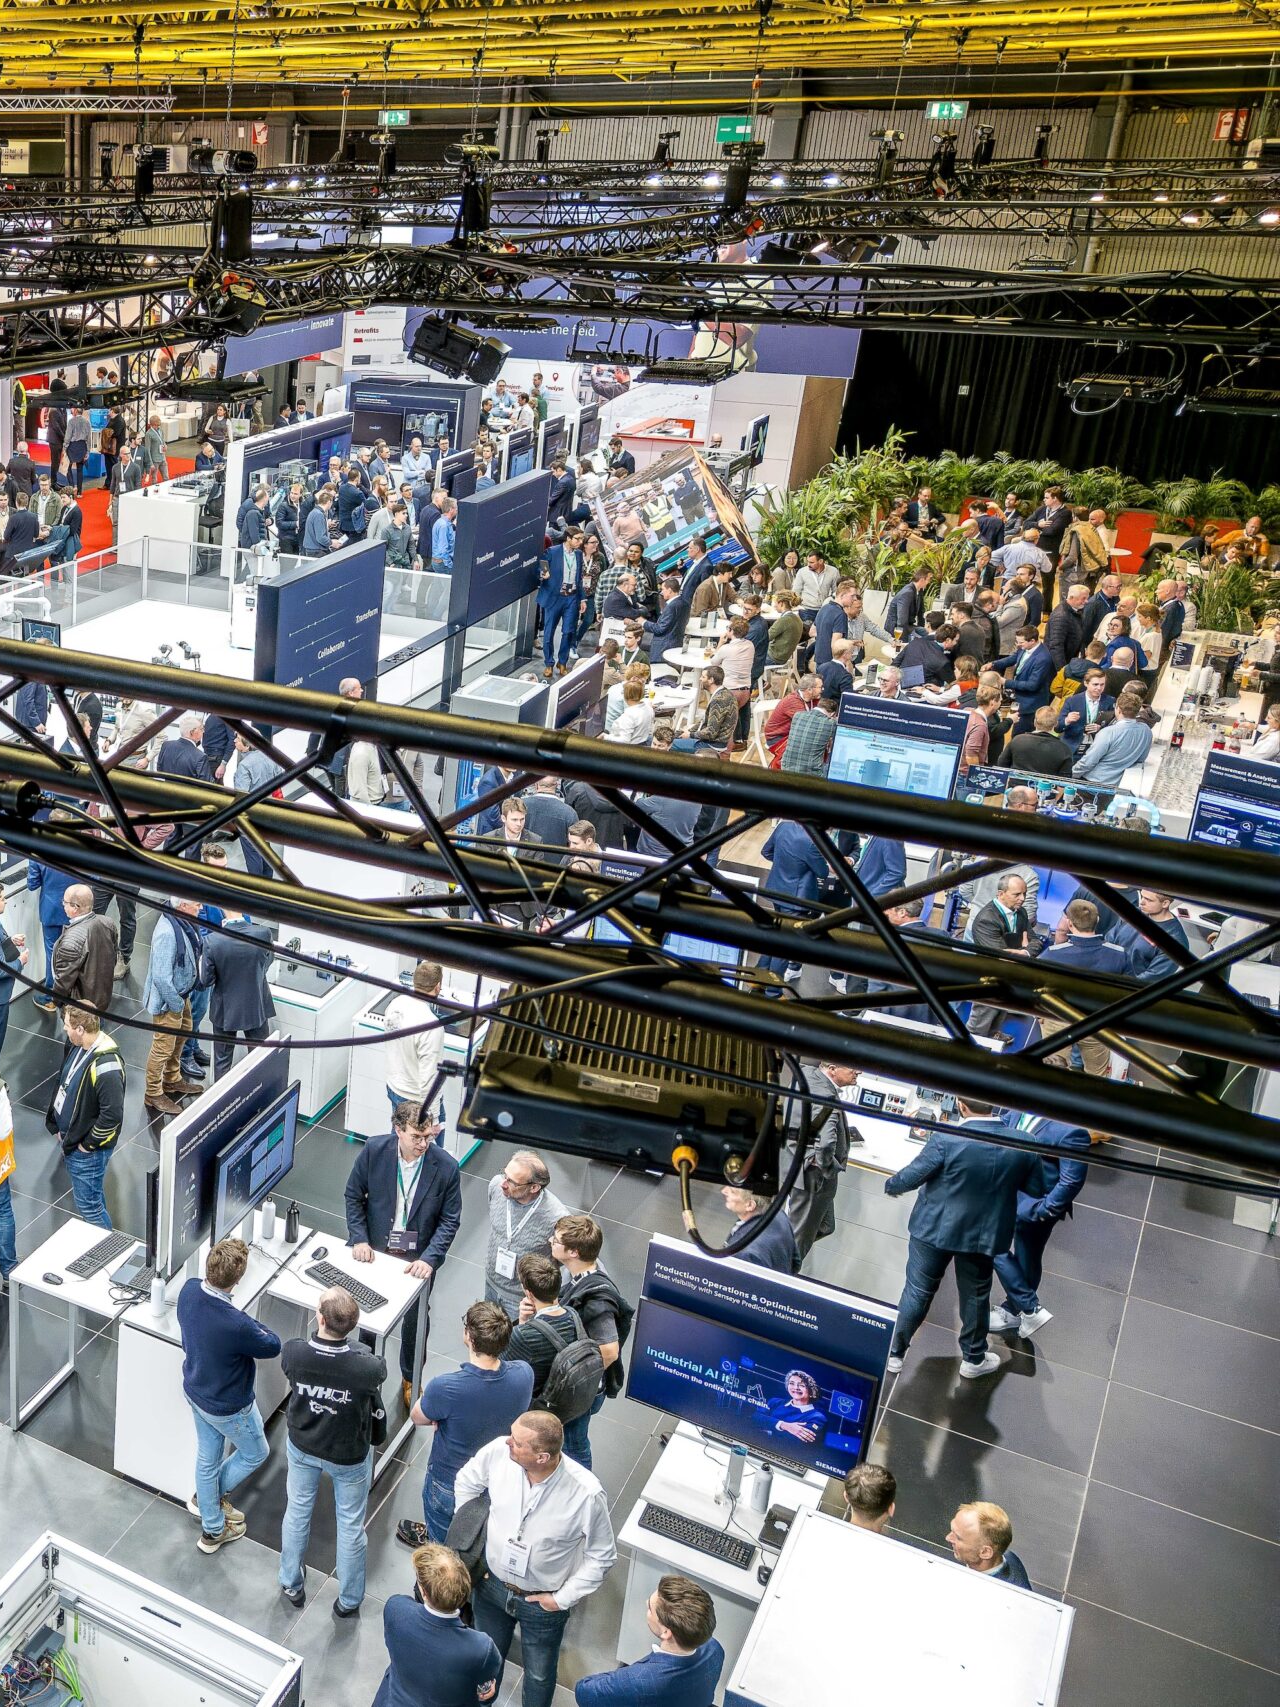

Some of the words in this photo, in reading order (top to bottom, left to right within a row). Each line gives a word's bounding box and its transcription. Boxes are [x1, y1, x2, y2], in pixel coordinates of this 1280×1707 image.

[354, 327, 380, 335] Retrofits
[572, 324, 598, 337] feld.
[355, 607, 378, 624] Transform
[317, 639, 345, 660] Collaborate
[1252, 772, 1278, 783] Analytics
[655, 1261, 700, 1284] Production
[701, 1277, 750, 1300] Operations
[750, 1291, 758, 1301] &
[759, 1296, 817, 1322] Optimization
[653, 1271, 671, 1281] Asset
[671, 1275, 698, 1291] visibility
[698, 1284, 713, 1295] with
[713, 1290, 741, 1305] Senseye
[741, 1298, 774, 1315] Predictive
[774, 1308, 819, 1331] Maintenance
[851, 1312, 887, 1330] SIEMENS
[645, 1345, 703, 1374] Industrial
[704, 1367, 719, 1380] AI
[296, 1382, 333, 1399] TVH
[652, 1361, 691, 1380] Transform
[691, 1376, 703, 1385] the
[703, 1380, 726, 1393] entire
[726, 1388, 747, 1401] value
[747, 1395, 771, 1410] chain.
[815, 1460, 847, 1476] SIEMENS
